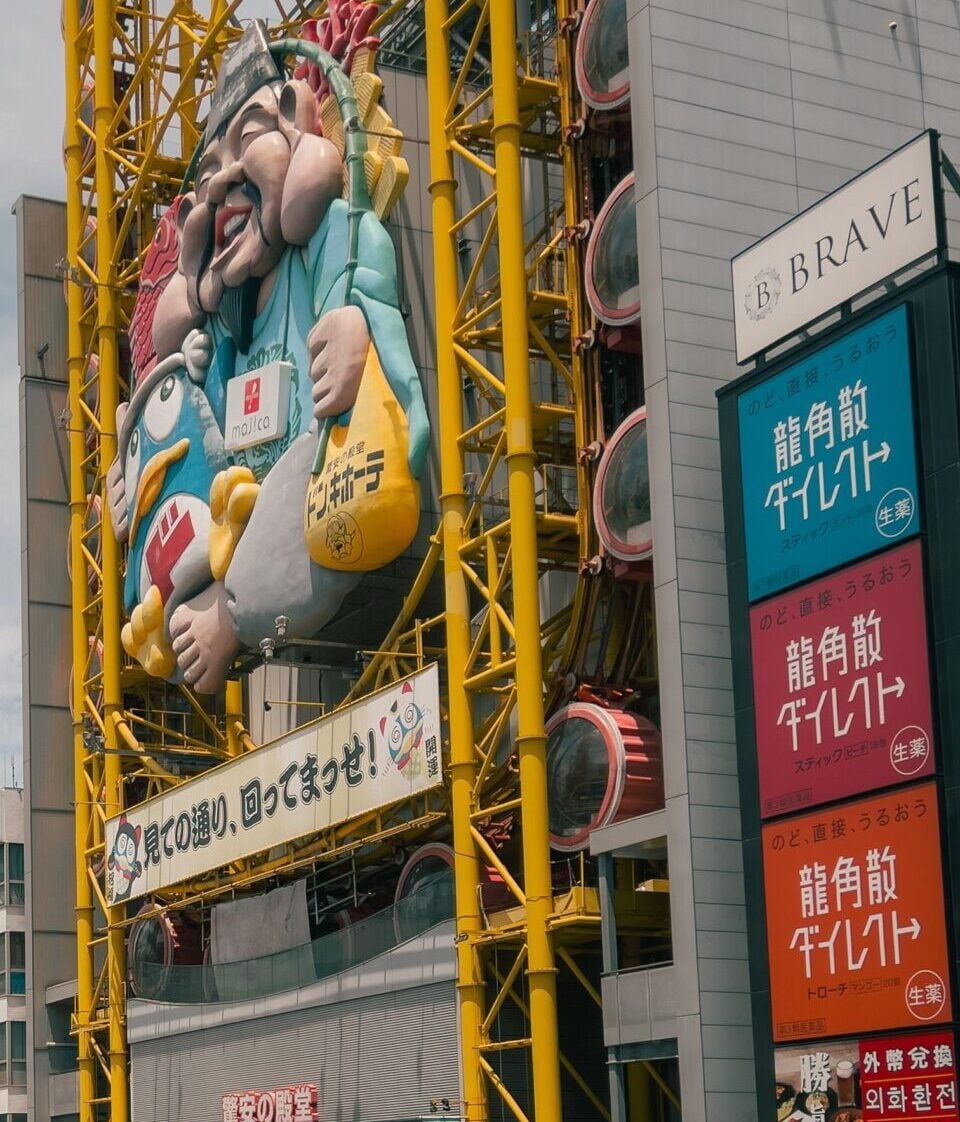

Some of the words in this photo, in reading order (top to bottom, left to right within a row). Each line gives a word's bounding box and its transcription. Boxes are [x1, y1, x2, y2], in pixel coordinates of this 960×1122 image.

[788, 178, 923, 295] BRAVE
[773, 378, 870, 474] 龍角散
[764, 439, 892, 531] ダイレクト
[878, 498, 911, 528] 生薬
[759, 558, 912, 631] のど、直接、うるおう
[786, 609, 883, 693] 龍角散
[776, 672, 906, 752] ダイレクト
[794, 749, 844, 774] スティック
[892, 737, 926, 764] 生薬
[771, 799, 928, 851] のど、直接、うるおう
[799, 845, 899, 919] 龍角散
[790, 911, 921, 979] ダイレクト
[807, 981, 848, 1000] トローチ
[908, 983, 942, 1006] 生薬
[800, 1052, 833, 1093] 勝
[865, 1080, 956, 1114] 외화환전
